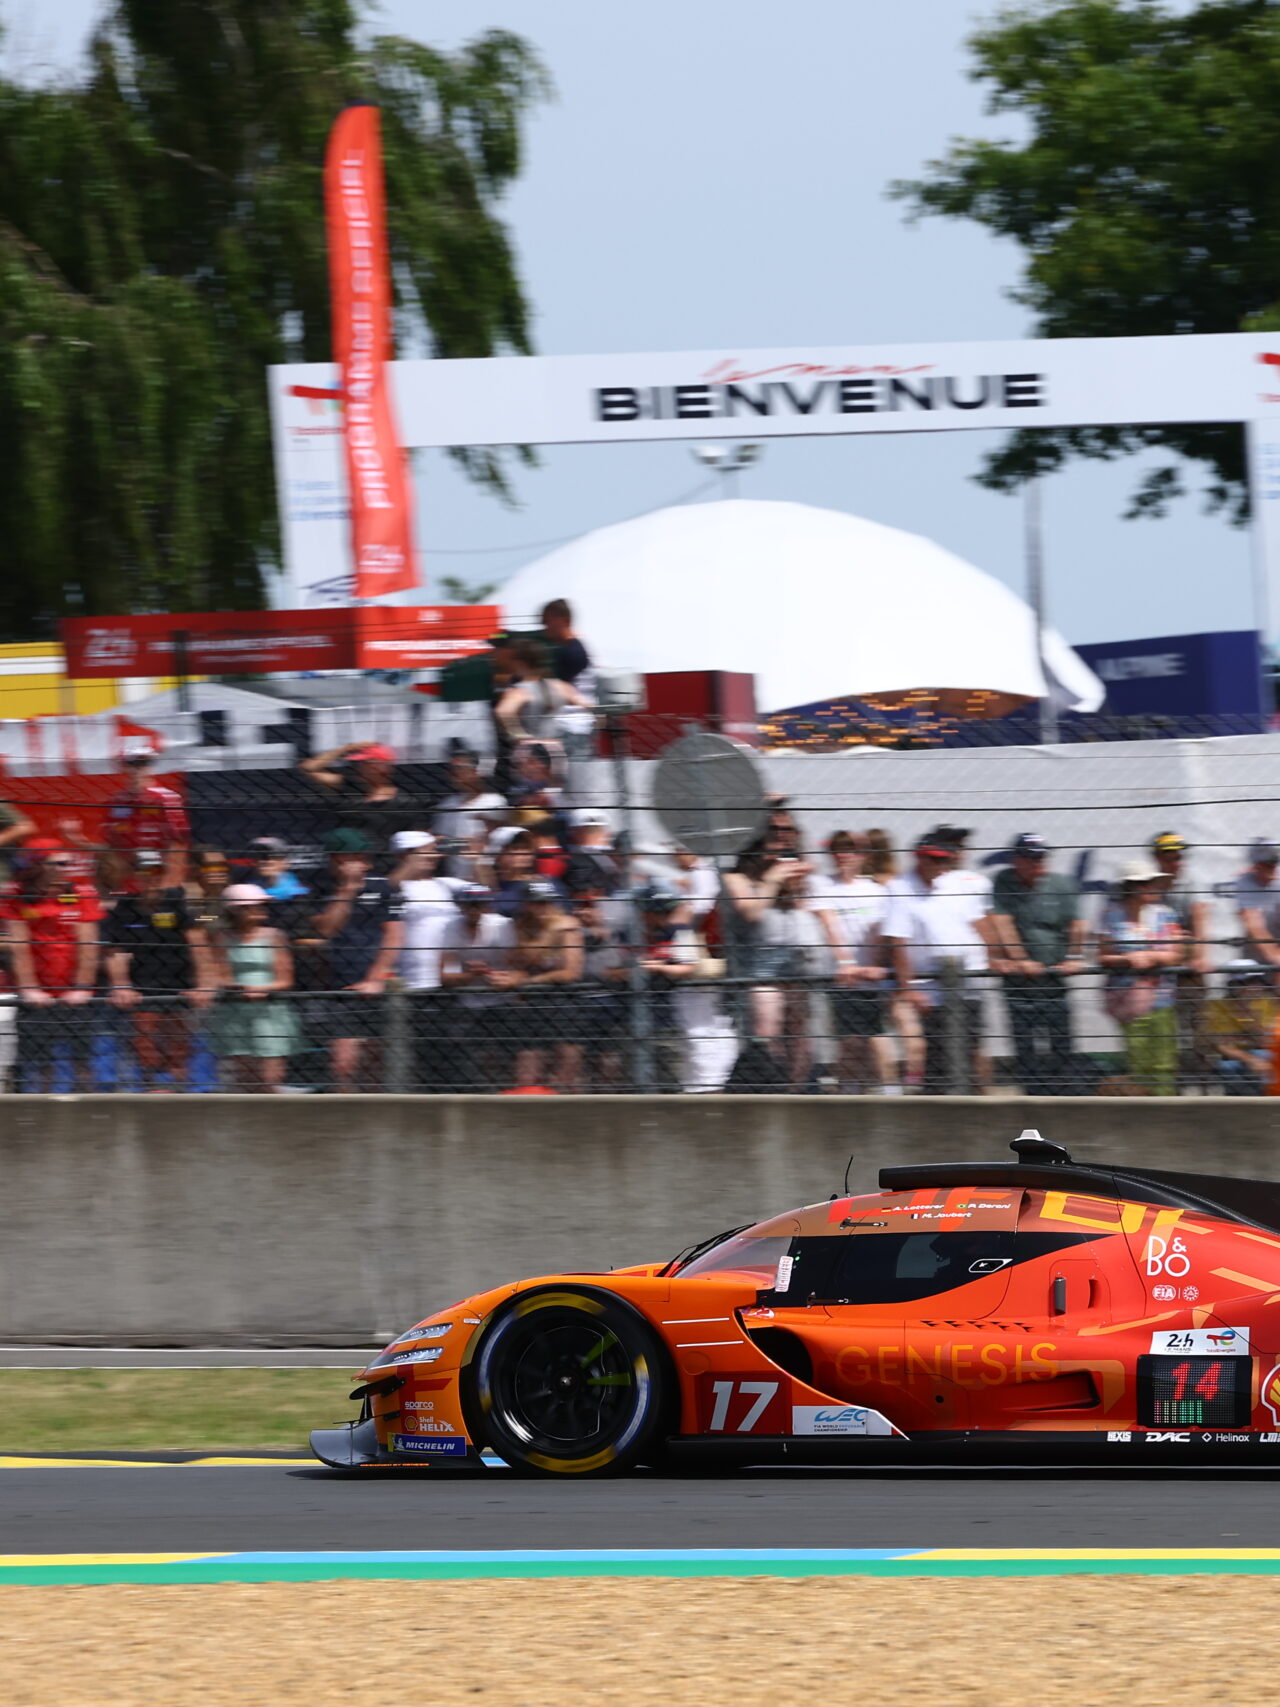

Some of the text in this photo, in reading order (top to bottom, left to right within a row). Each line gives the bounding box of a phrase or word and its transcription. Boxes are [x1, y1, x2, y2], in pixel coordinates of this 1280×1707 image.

[595, 373, 1045, 421] BIENVENUE
[835, 1343, 1059, 1386] GENESIS
[1171, 1361, 1222, 1400] 14
[709, 1381, 779, 1432] 17
[814, 1408, 869, 1422] WEC
[1106, 1431, 1131, 1442] HEXIS
[1145, 1432, 1190, 1442] DAC
[1215, 1433, 1250, 1442] Helinox
[405, 1442, 455, 1450] MICHELIN
